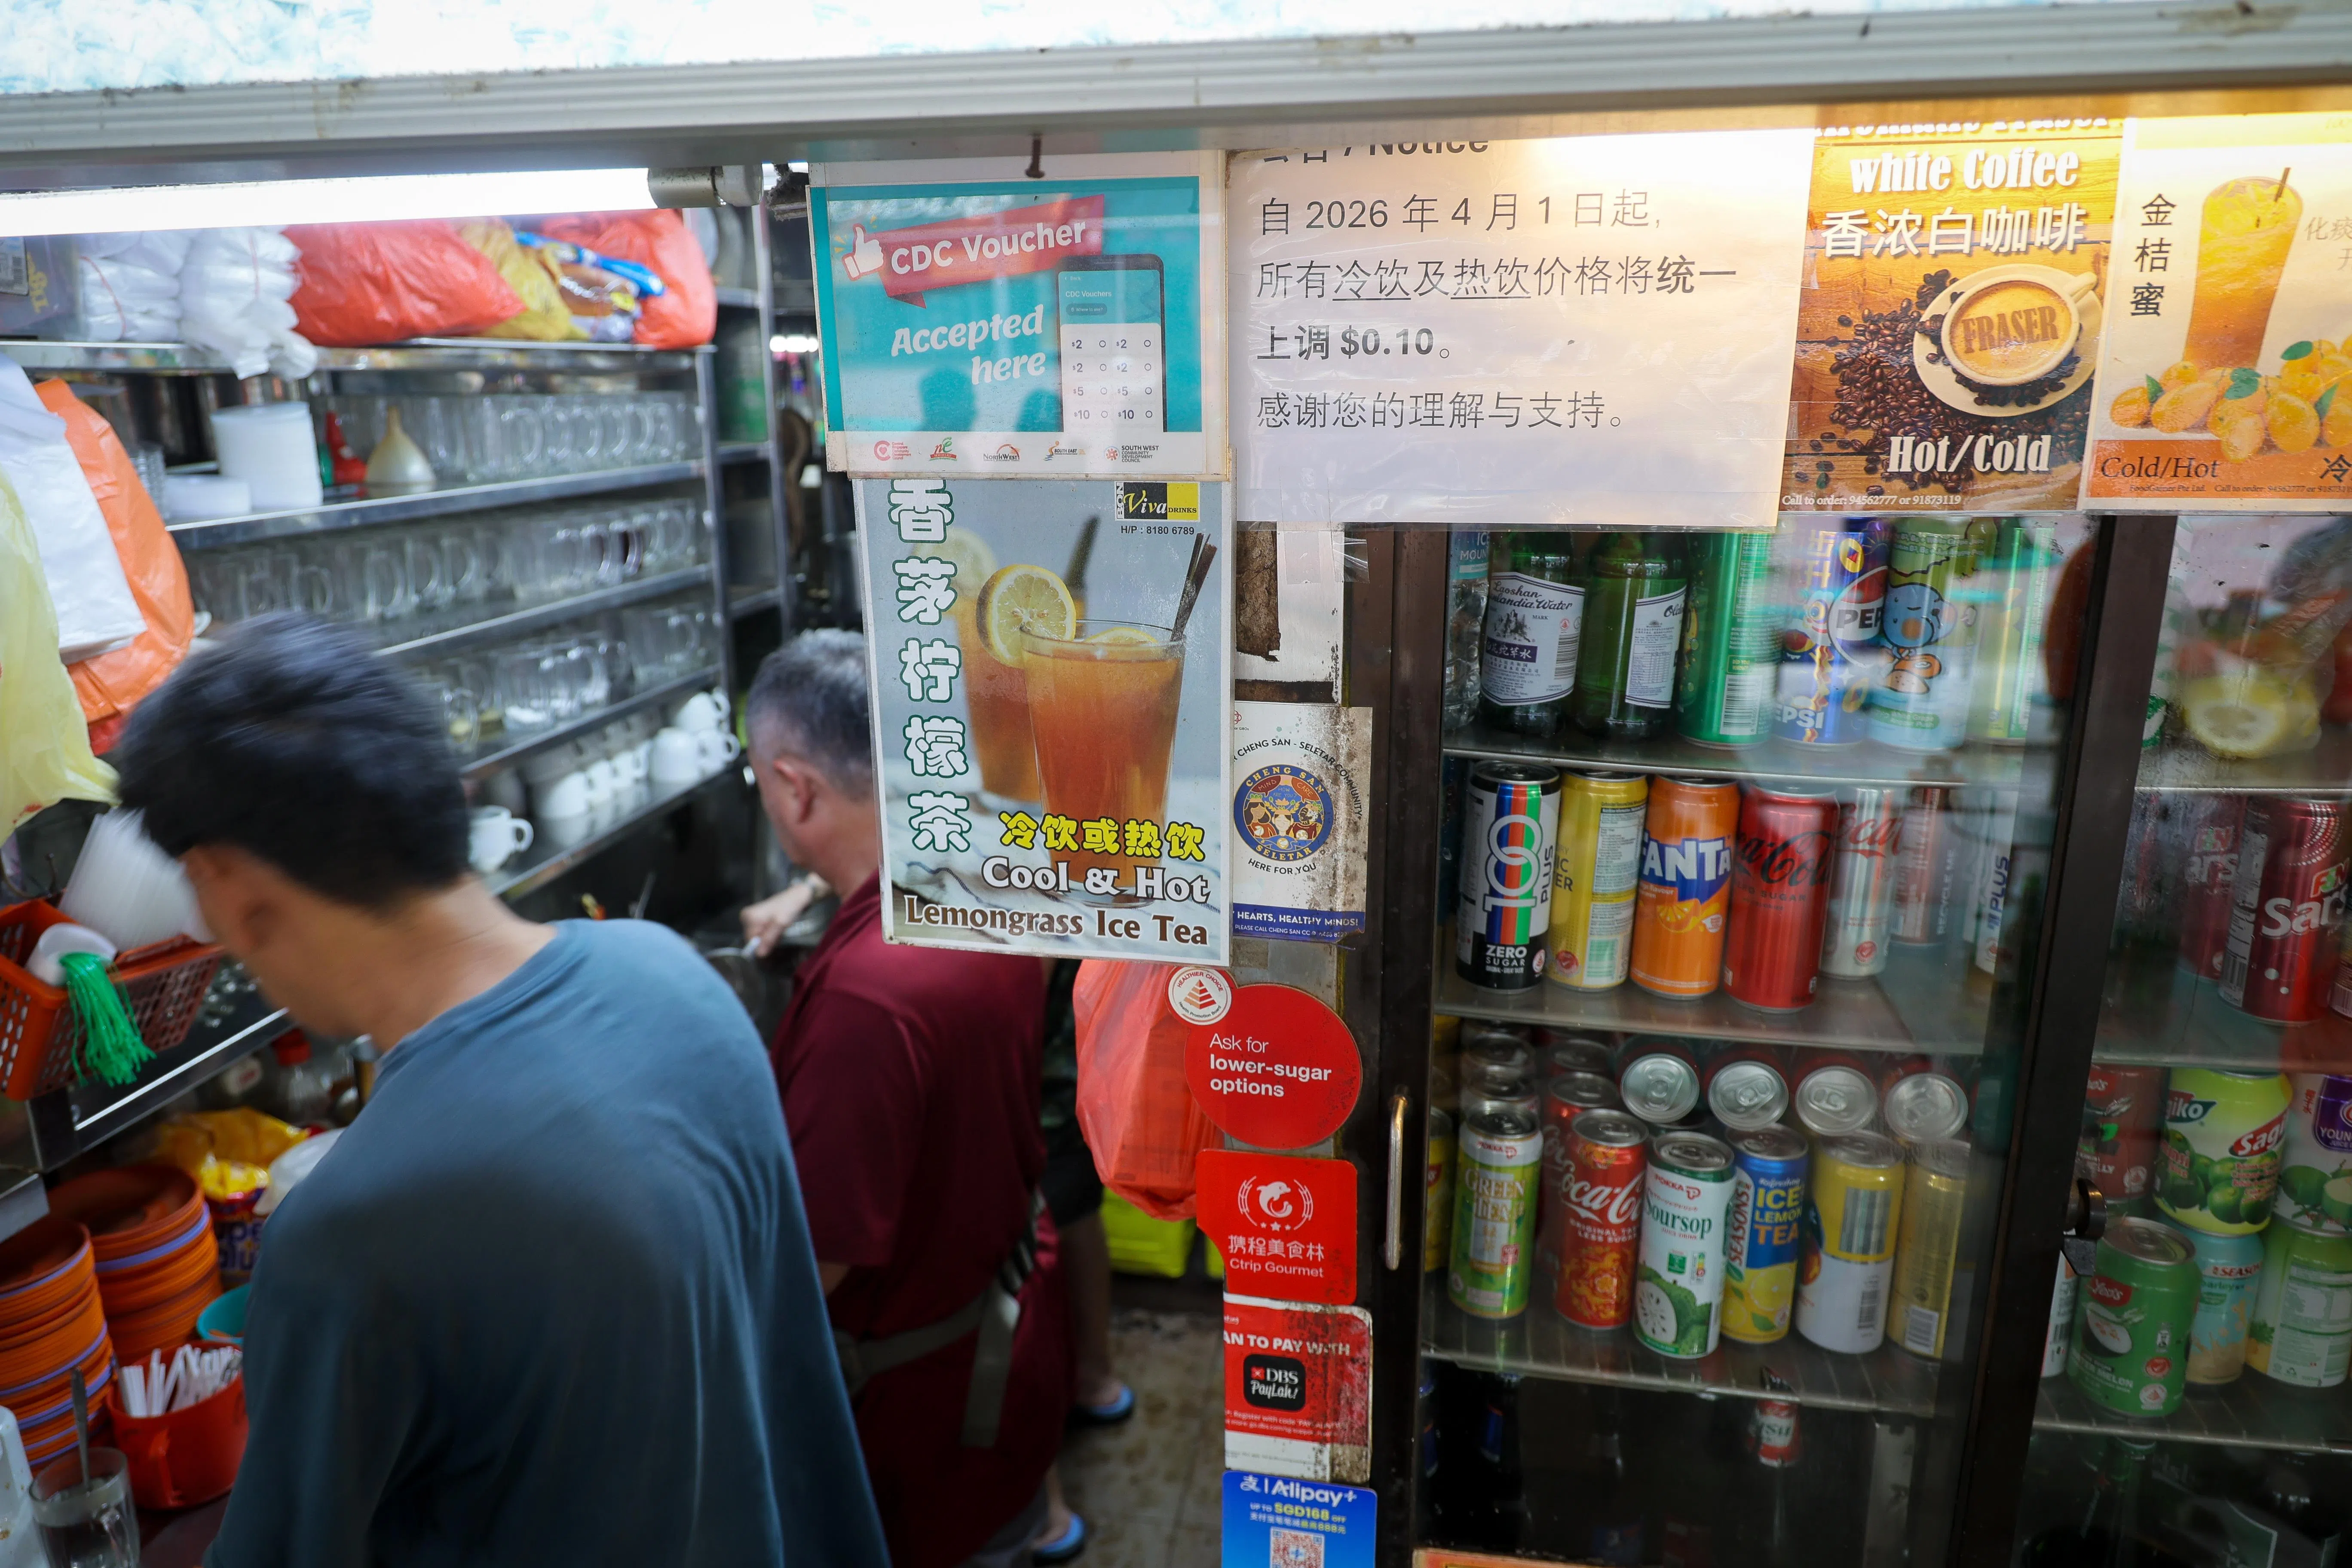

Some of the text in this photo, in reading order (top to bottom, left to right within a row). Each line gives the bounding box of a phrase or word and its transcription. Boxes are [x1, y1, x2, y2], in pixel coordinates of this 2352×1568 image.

[1963, 147, 2079, 190] Coffee
[1262, 197, 1289, 236] 自
[1305, 199, 1388, 230] 2026
[1402, 193, 1439, 233] 年
[1451, 197, 1472, 226] 4
[1485, 193, 1517, 231] 月
[1538, 196, 1550, 224] 1
[1822, 202, 2087, 258] 香浓白咖啡
[890, 220, 1087, 275] CDC Voucher
[2130, 193, 2177, 317] 金桔蜜
[1256, 254, 1736, 299] 所有冷饮及热饮价格将统一
[890, 303, 1044, 357] Accepted
[1962, 306, 2059, 353] FRASER
[1072, 339, 1127, 349] $2 $2
[1256, 324, 1330, 361] 上调
[971, 351, 1046, 386] here
[1072, 362, 1127, 373] $2 $2
[1073, 386, 1128, 396] $5 $5
[1074, 409, 1134, 420] $10 $10
[1257, 390, 1623, 430] 感谢您的理解与支持。
[1886, 435, 2051, 473] Hot/Cold
[2101, 456, 2221, 479] Cold/Hot
[1116, 481, 1124, 519] BON
[1123, 490, 1167, 514] Viva
[1782, 495, 1803, 505] Call
[1804, 496, 1815, 505] to
[1816, 495, 1847, 505] order:
[1848, 495, 1898, 505] 94562777
[1912, 495, 1962, 505] 91873119
[1121, 525, 1194, 535] H/P 8180 6789
[1237, 740, 1269, 756] CHENG
[1299, 741, 1335, 766] SELETAR
[1335, 764, 1363, 816] COMMUNITY
[1246, 766, 1324, 793] CHENG SAN
[1258, 779, 1277, 791] MIND
[1296, 782, 1314, 797] CARE
[998, 810, 1206, 862] 冷饮或热饮
[1256, 845, 1313, 860] SELETAR
[1642, 832, 1731, 882] ANTA
[1248, 858, 1271, 872] HERE
[1295, 862, 1317, 874] YOU
[1540, 845, 1554, 904] PLUS
[981, 855, 1210, 906] Cool & Hot
[1988, 855, 2010, 914] PLUS
[903, 894, 1208, 947] Lemongrass Ice Tea
[1237, 911, 1276, 923] HEARTS,
[1279, 915, 1321, 925] HEALTHY
[1485, 944, 1527, 959] ZERO
[1485, 956, 1525, 967] SUGAR
[1177, 971, 1224, 992] HEALTHIER CHOICE
[1178, 1001, 1222, 1019] Health Promotion Board
[1209, 1032, 1269, 1053] Ask for
[1210, 1053, 1332, 1082] lower-sugar
[1210, 1078, 1284, 1097] options
[1655, 1173, 1684, 1192] POKKA
[1756, 1185, 1802, 1210] ICE
[1646, 1187, 1713, 1240] Soursop
[1754, 1206, 1802, 1224] LEMON
[1729, 1187, 1750, 1266] SEASONS
[1753, 1221, 1799, 1246] TEA
[1228, 1234, 1324, 1262] 携程美食林
[1229, 1257, 1324, 1278] Ctrip Gourmet
[1246, 1334, 1269, 1349] TO
[1272, 1337, 1303, 1353] PAY
[1266, 1368, 1299, 1385] DBS
[1250, 1379, 1299, 1400] PayLah!
[1274, 1502, 1330, 1522] SGD168
